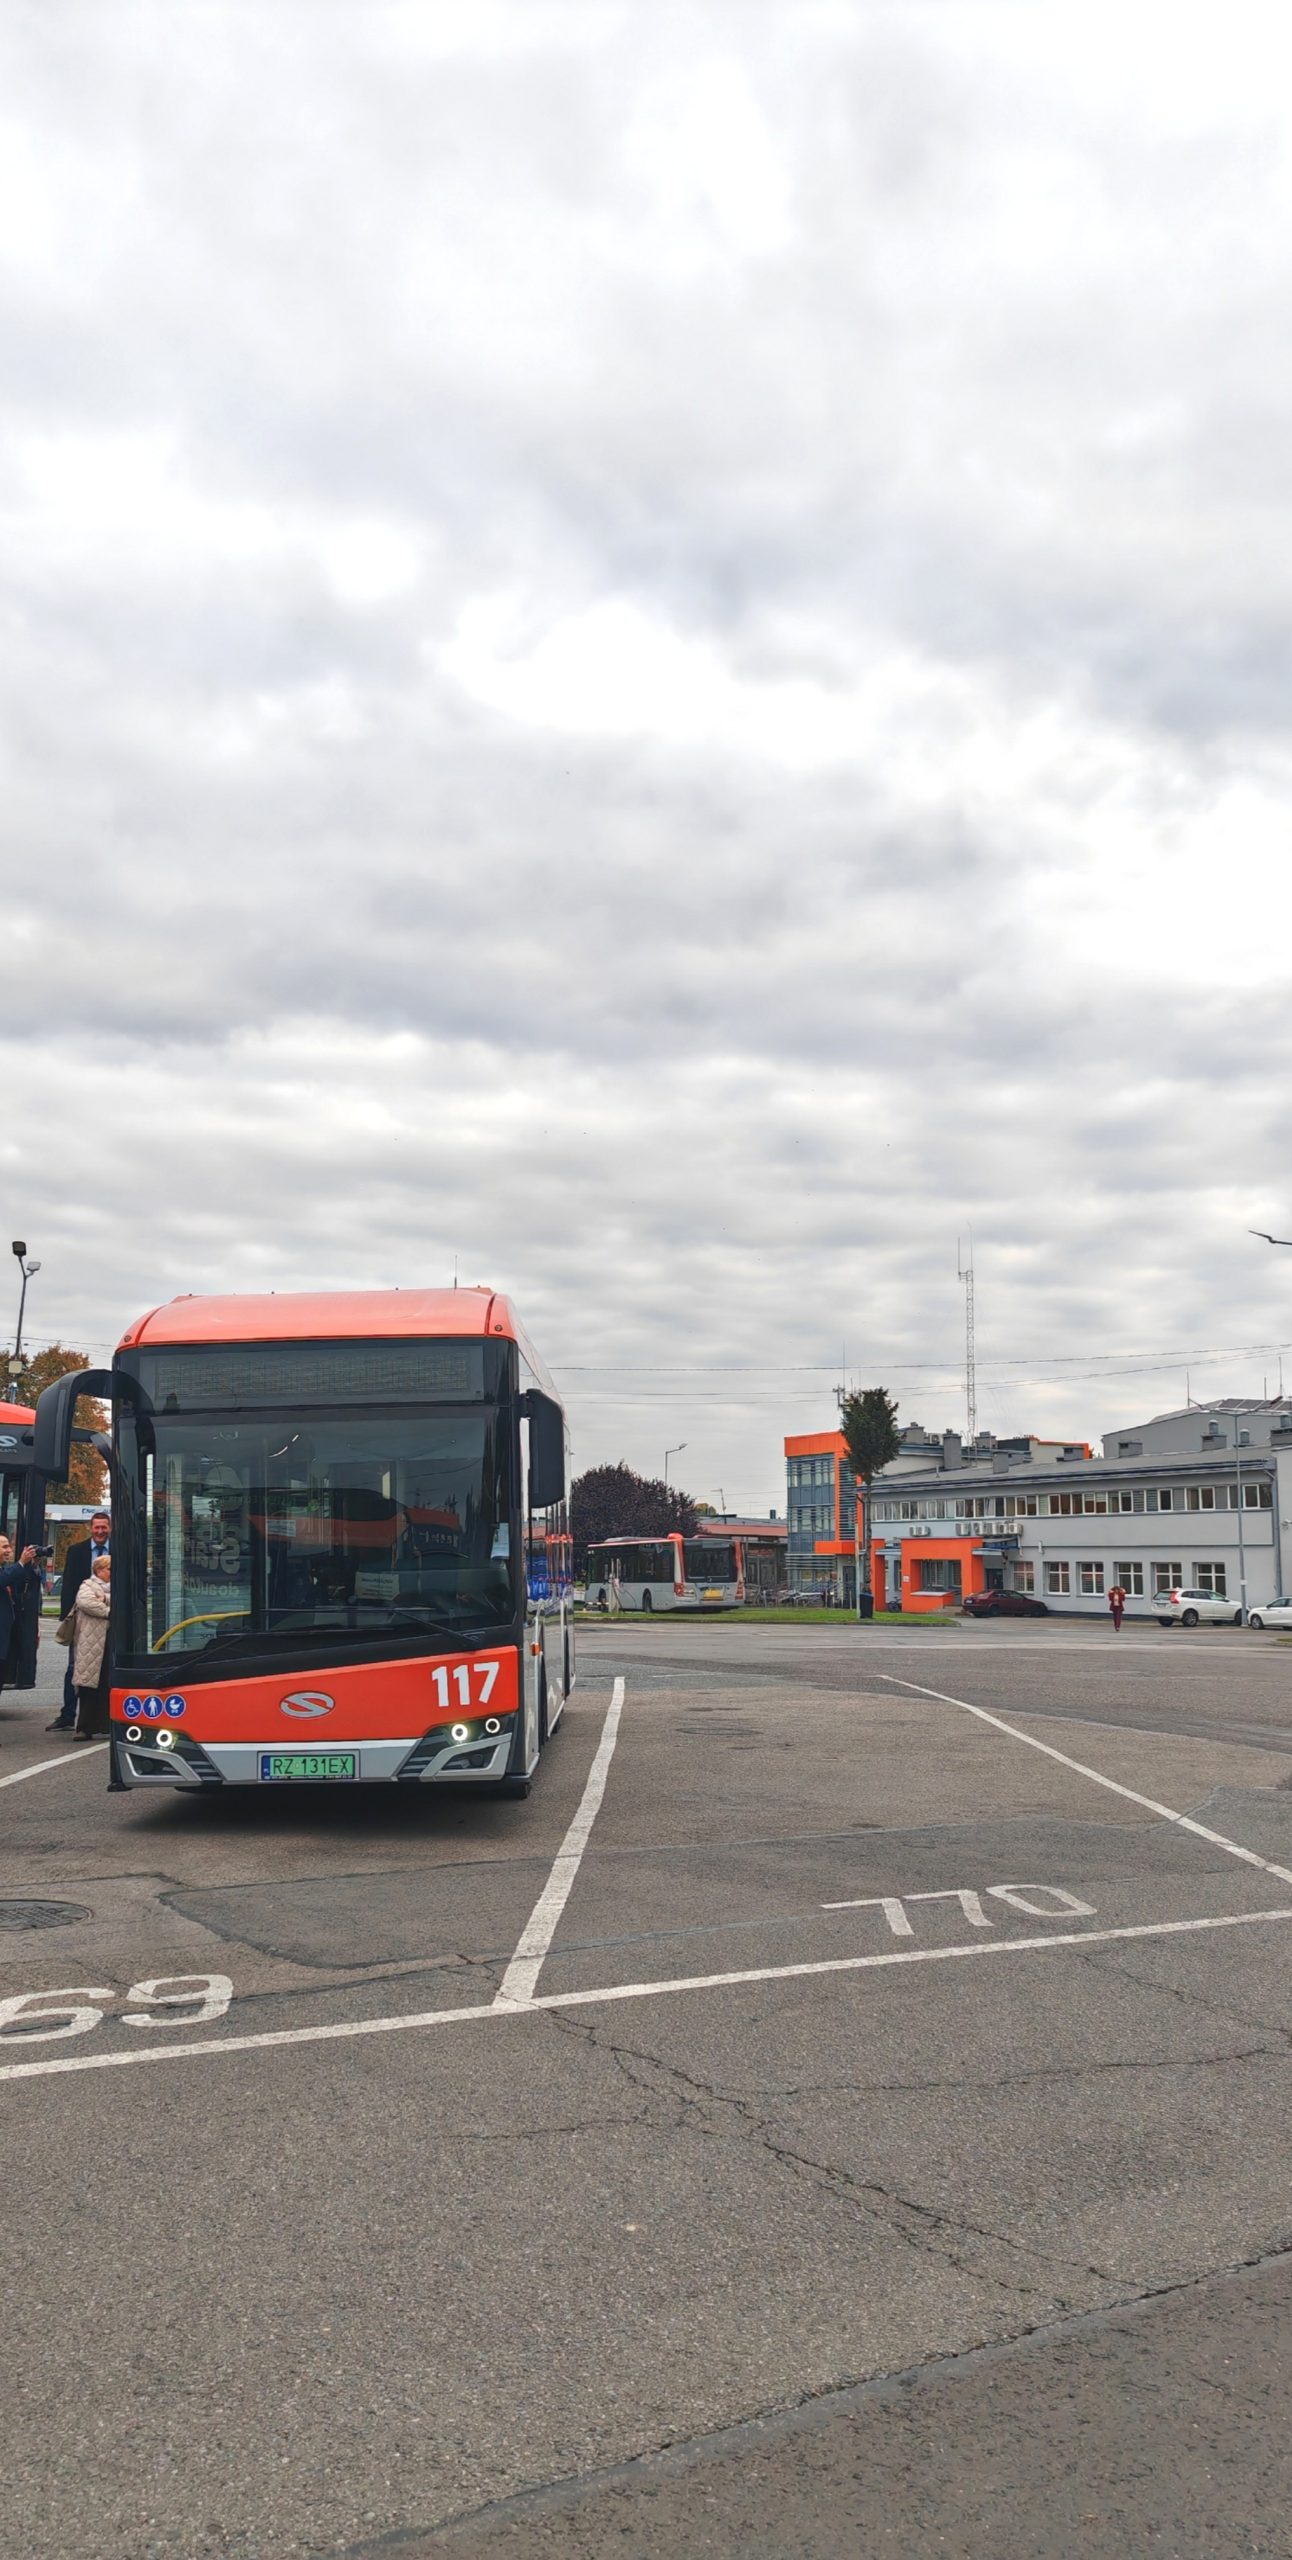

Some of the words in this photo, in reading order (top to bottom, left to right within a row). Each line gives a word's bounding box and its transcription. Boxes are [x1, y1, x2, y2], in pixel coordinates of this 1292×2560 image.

[432, 1661, 500, 1707] 117
[273, 1758, 294, 1775] RZ
[301, 1757, 349, 1774] 131EX
[820, 1884, 1097, 1935] 770
[0, 1974, 234, 2044] 69
